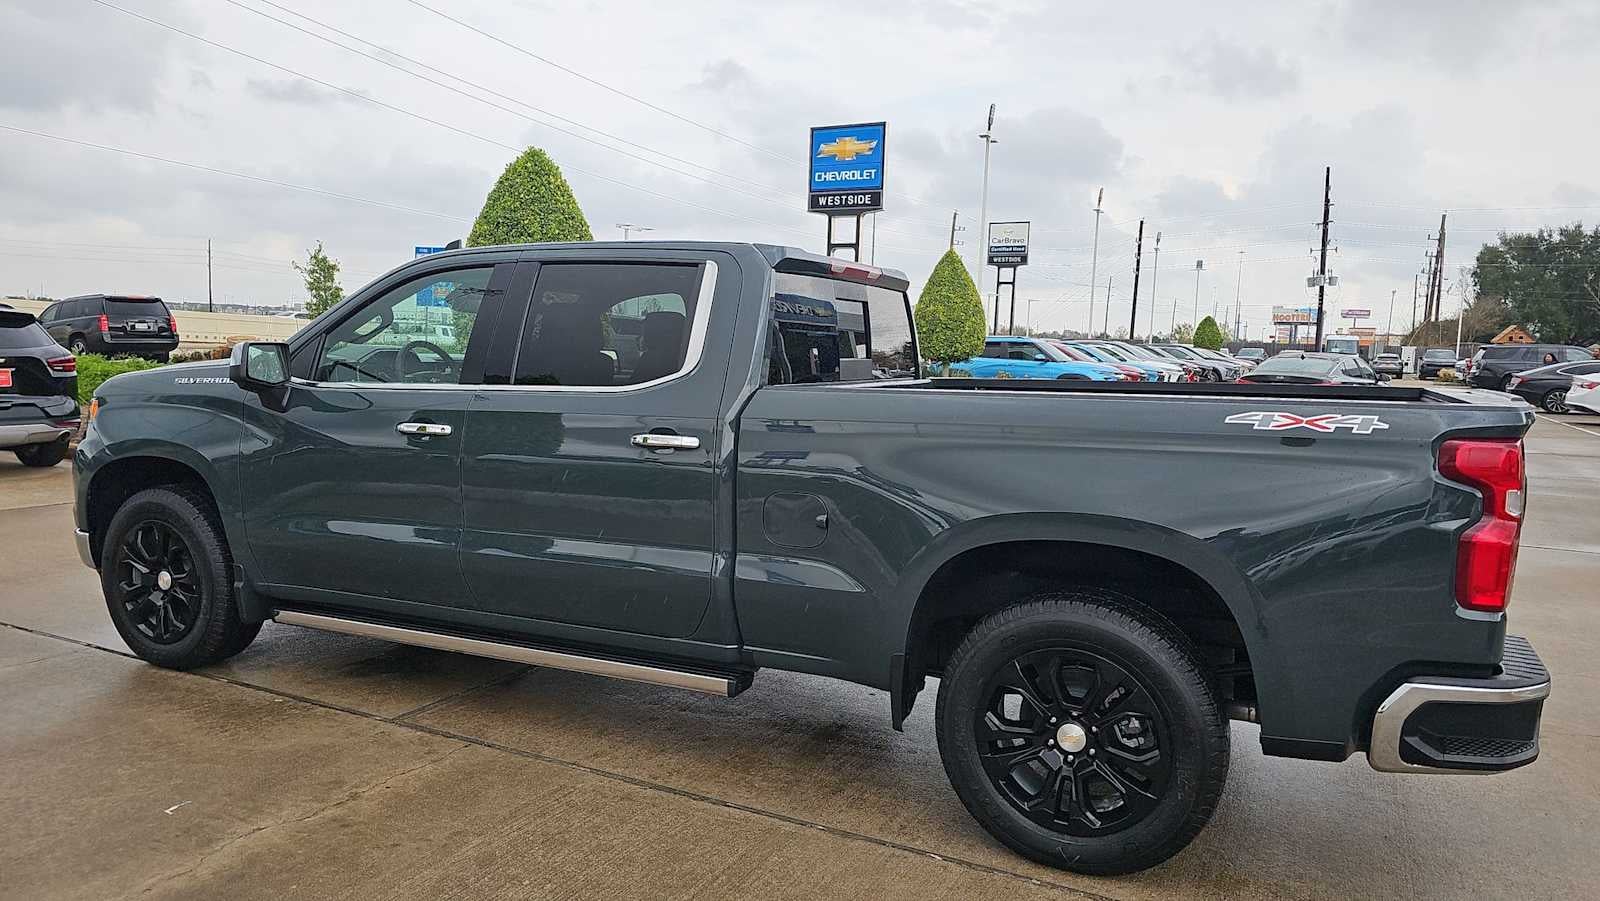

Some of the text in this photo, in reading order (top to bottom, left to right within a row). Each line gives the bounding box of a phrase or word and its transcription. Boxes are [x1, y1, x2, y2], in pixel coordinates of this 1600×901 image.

[815, 169, 877, 182] CHEVROLET
[818, 194, 872, 206] WESTSIDE
[991, 236, 1025, 244] CarBravo
